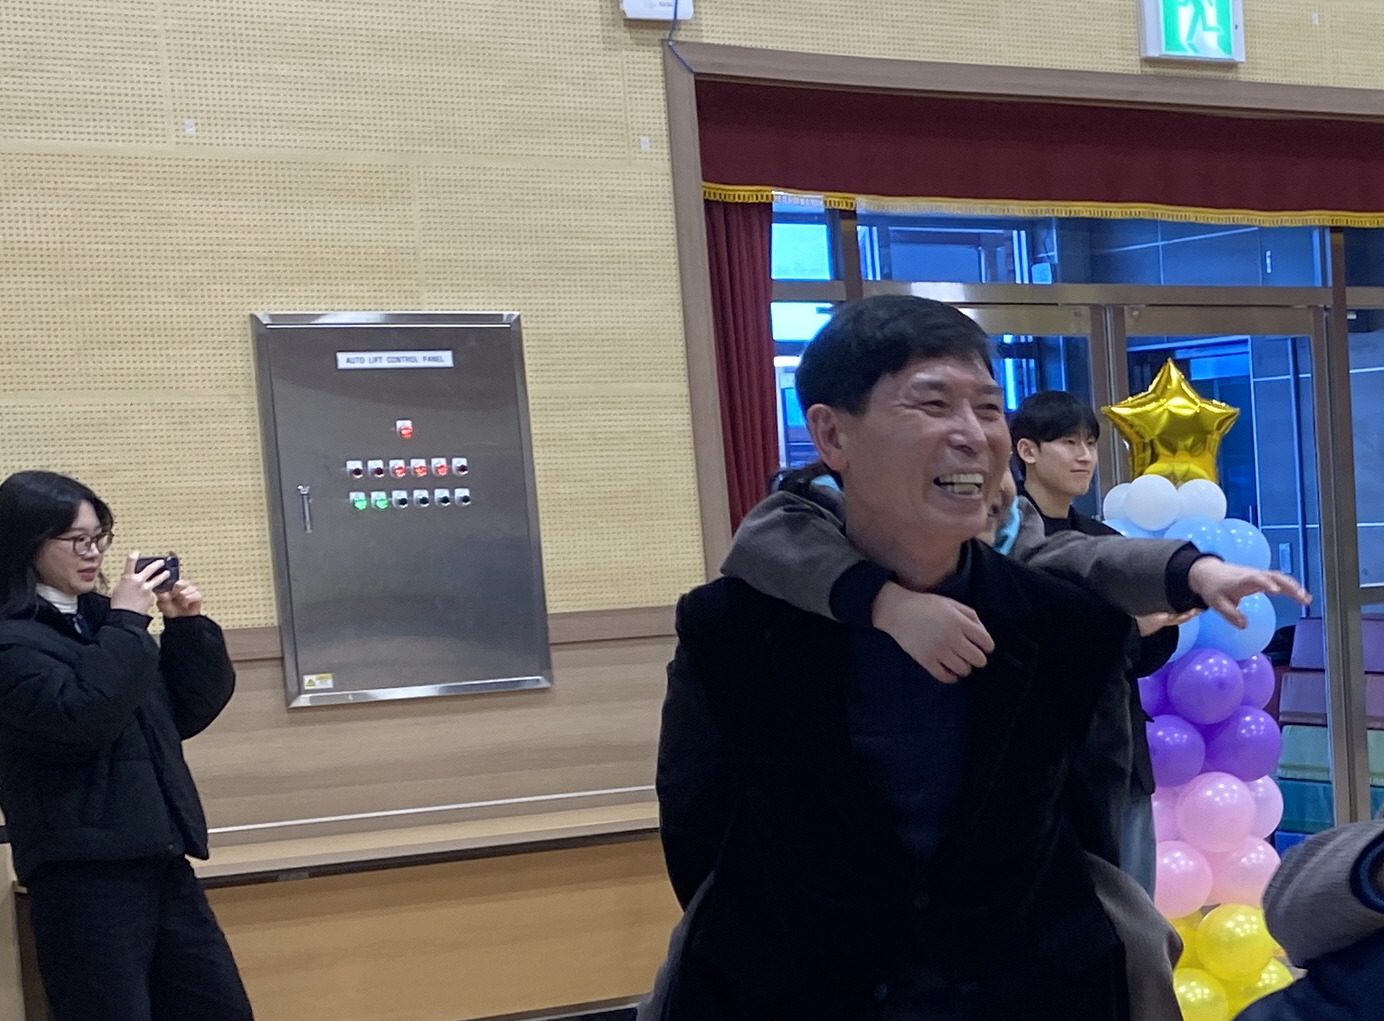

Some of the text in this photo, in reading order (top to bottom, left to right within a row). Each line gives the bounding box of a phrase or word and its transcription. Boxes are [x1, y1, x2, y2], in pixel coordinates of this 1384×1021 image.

[346, 355, 445, 364] AUTO LIFT CONTROL PANEL
